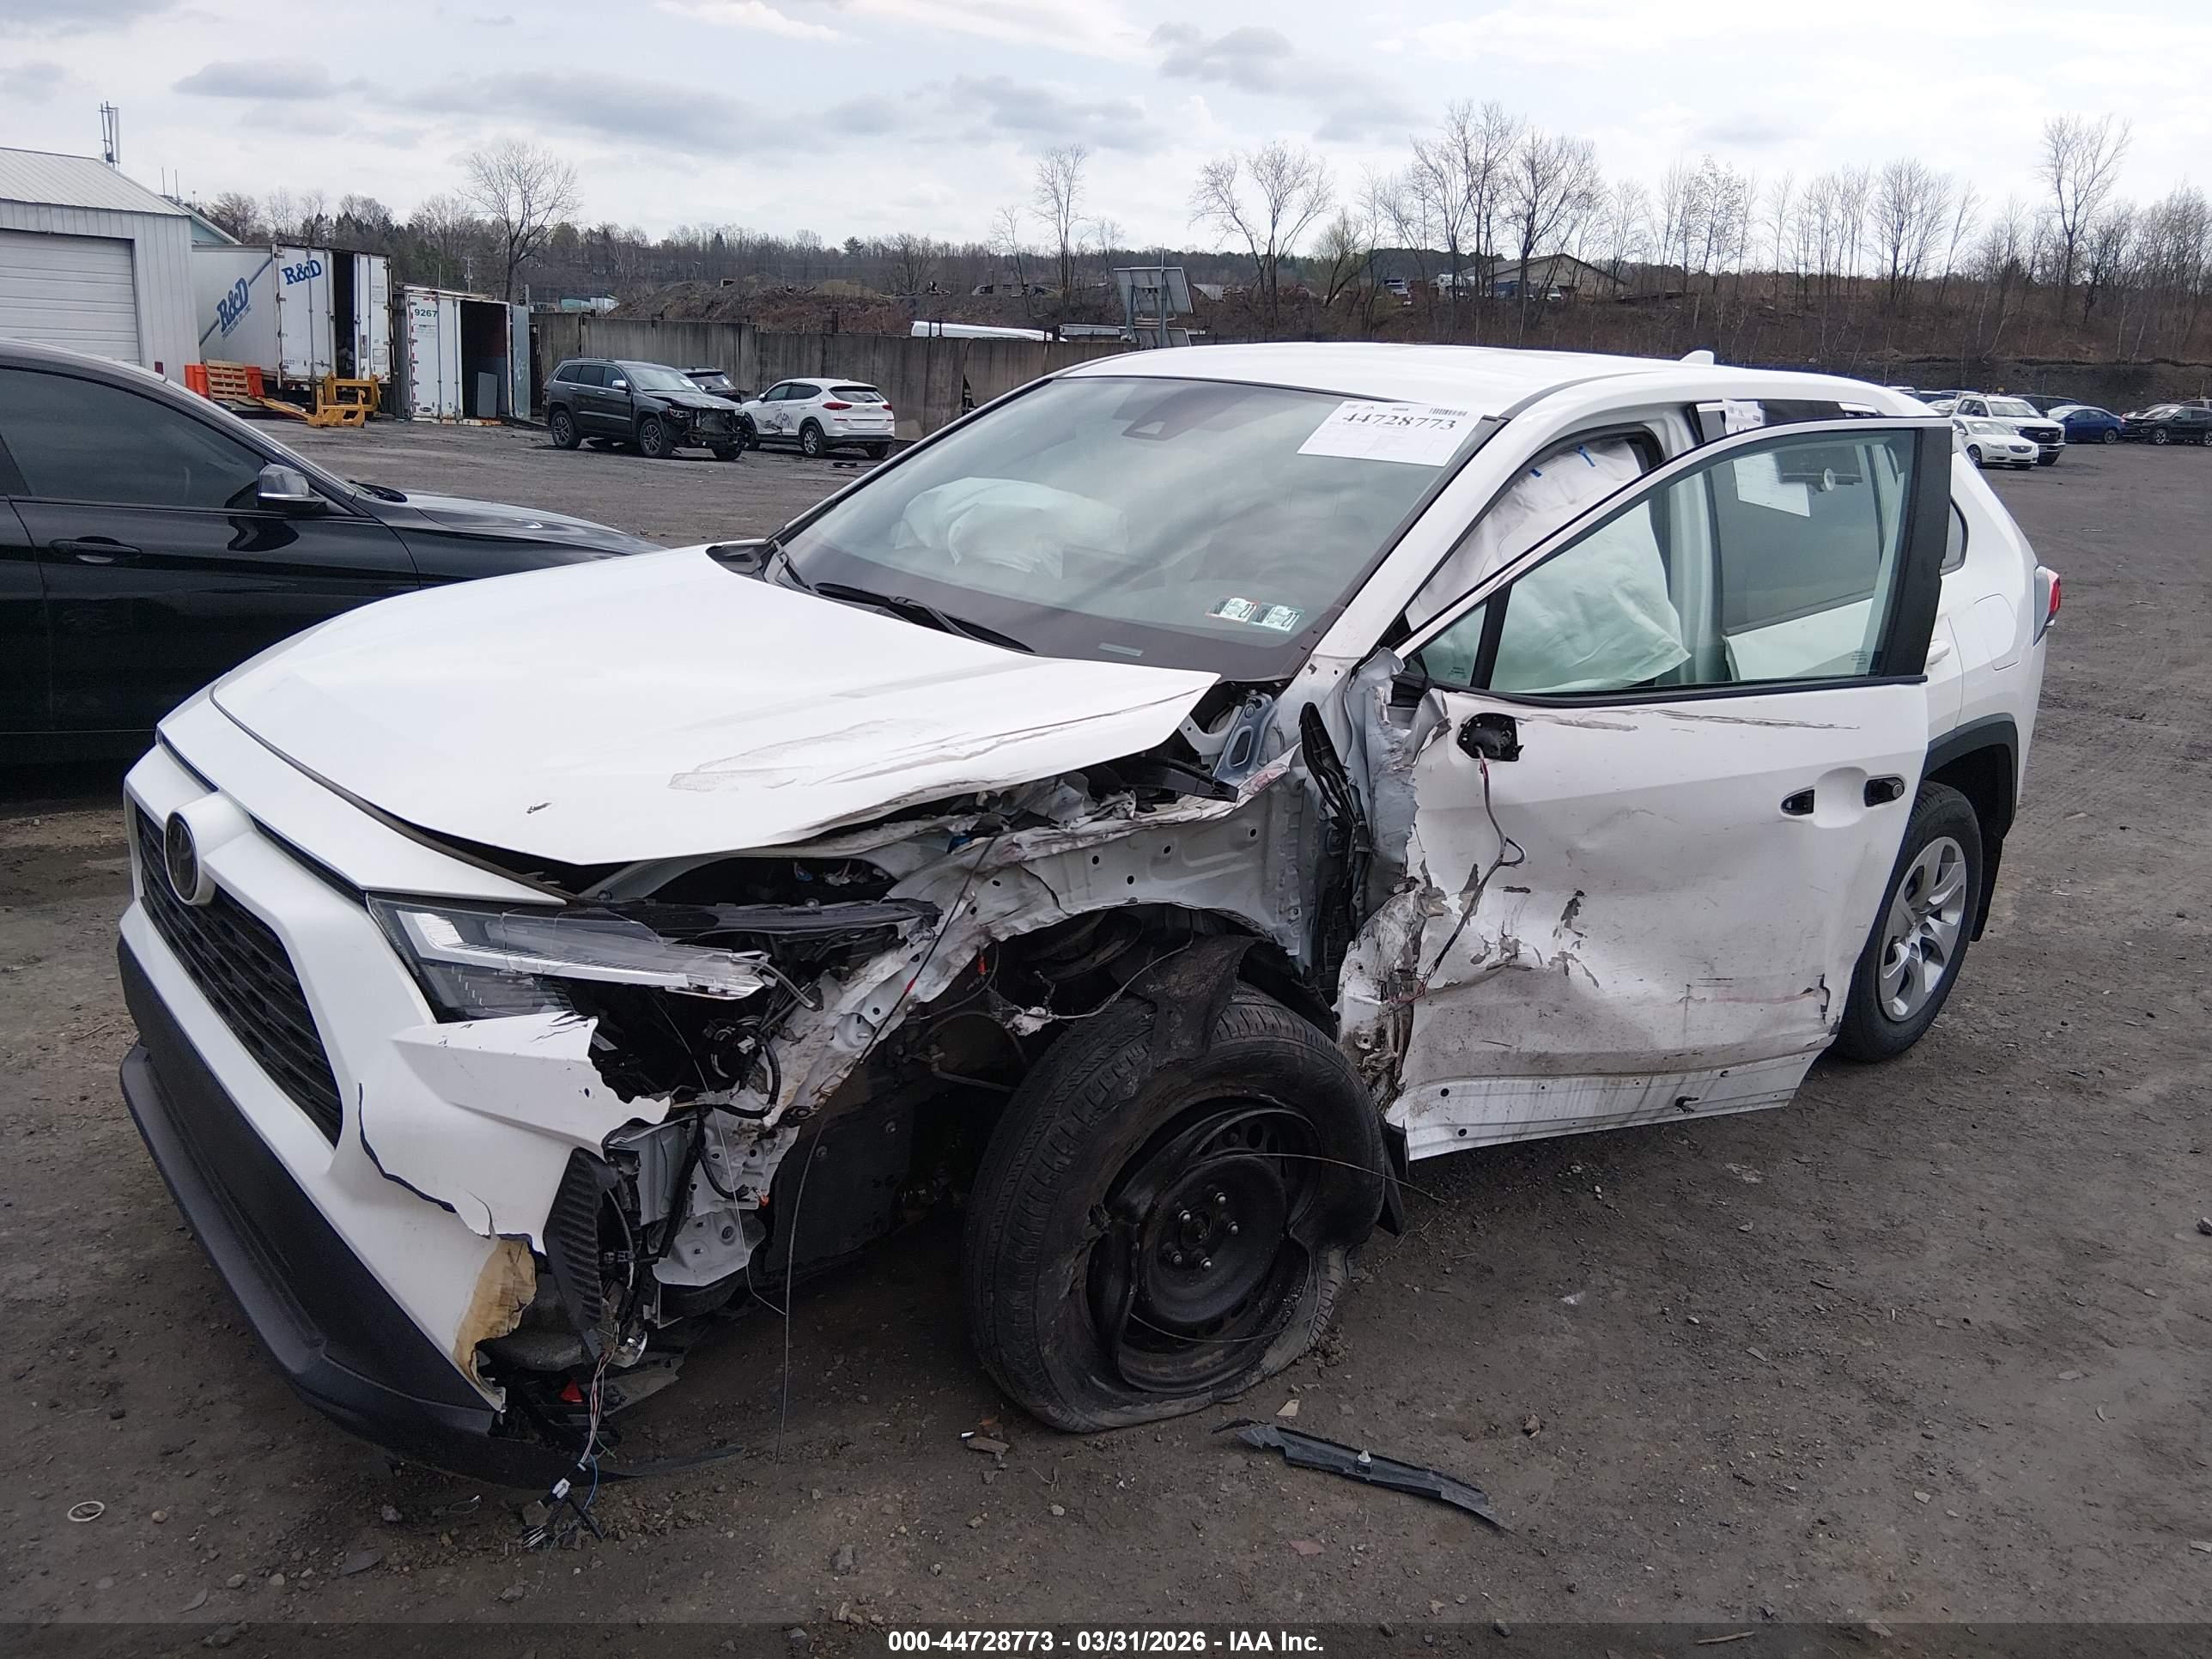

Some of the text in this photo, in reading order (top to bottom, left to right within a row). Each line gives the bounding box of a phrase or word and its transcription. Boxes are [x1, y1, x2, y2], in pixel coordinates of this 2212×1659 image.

[282, 260, 322, 285] R&D
[216, 277, 249, 332] R&D
[414, 308, 439, 318] 9267
[1343, 412, 1456, 430] 44728773
